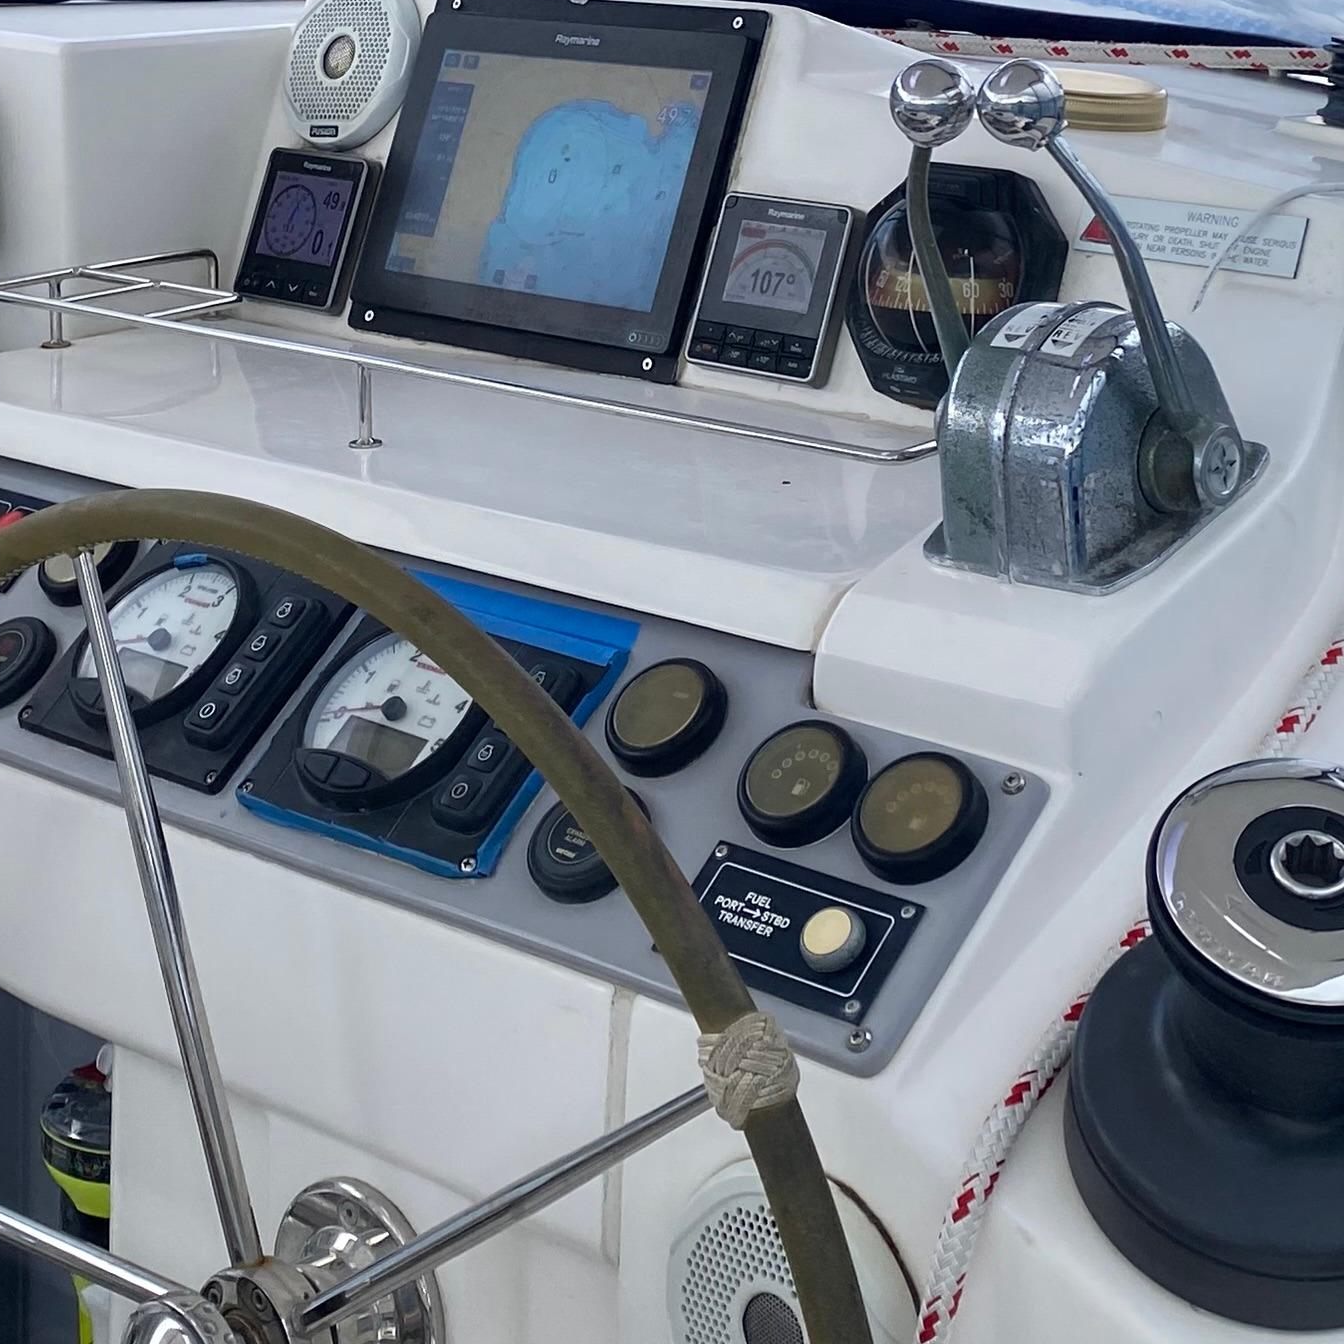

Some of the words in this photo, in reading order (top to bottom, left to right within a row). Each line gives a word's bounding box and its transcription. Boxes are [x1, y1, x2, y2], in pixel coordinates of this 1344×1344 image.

[555, 34, 601, 47] Raymarine
[767, 208, 805, 221] Raymarine
[1187, 211, 1240, 228] WARNING
[1163, 224, 1207, 239] PROPELLER
[1212, 231, 1229, 241] MAY
[1262, 238, 1298, 250] SERIOUS
[1146, 243, 1167, 254] NEAR
[1171, 247, 1207, 260] PERSONS
[751, 268, 796, 297] 107°
[962, 282, 980, 298] 60
[998, 282, 1014, 298] 30
[178, 585, 192, 598] 2
[212, 595, 225, 608] 3
[409, 649, 424, 662] 2
[455, 699, 469, 714] 4
[745, 891, 772, 909] FUEL
[714, 895, 746, 913] PORT
[760, 911, 791, 929] STBD
[718, 909, 774, 937] TRANSFER
